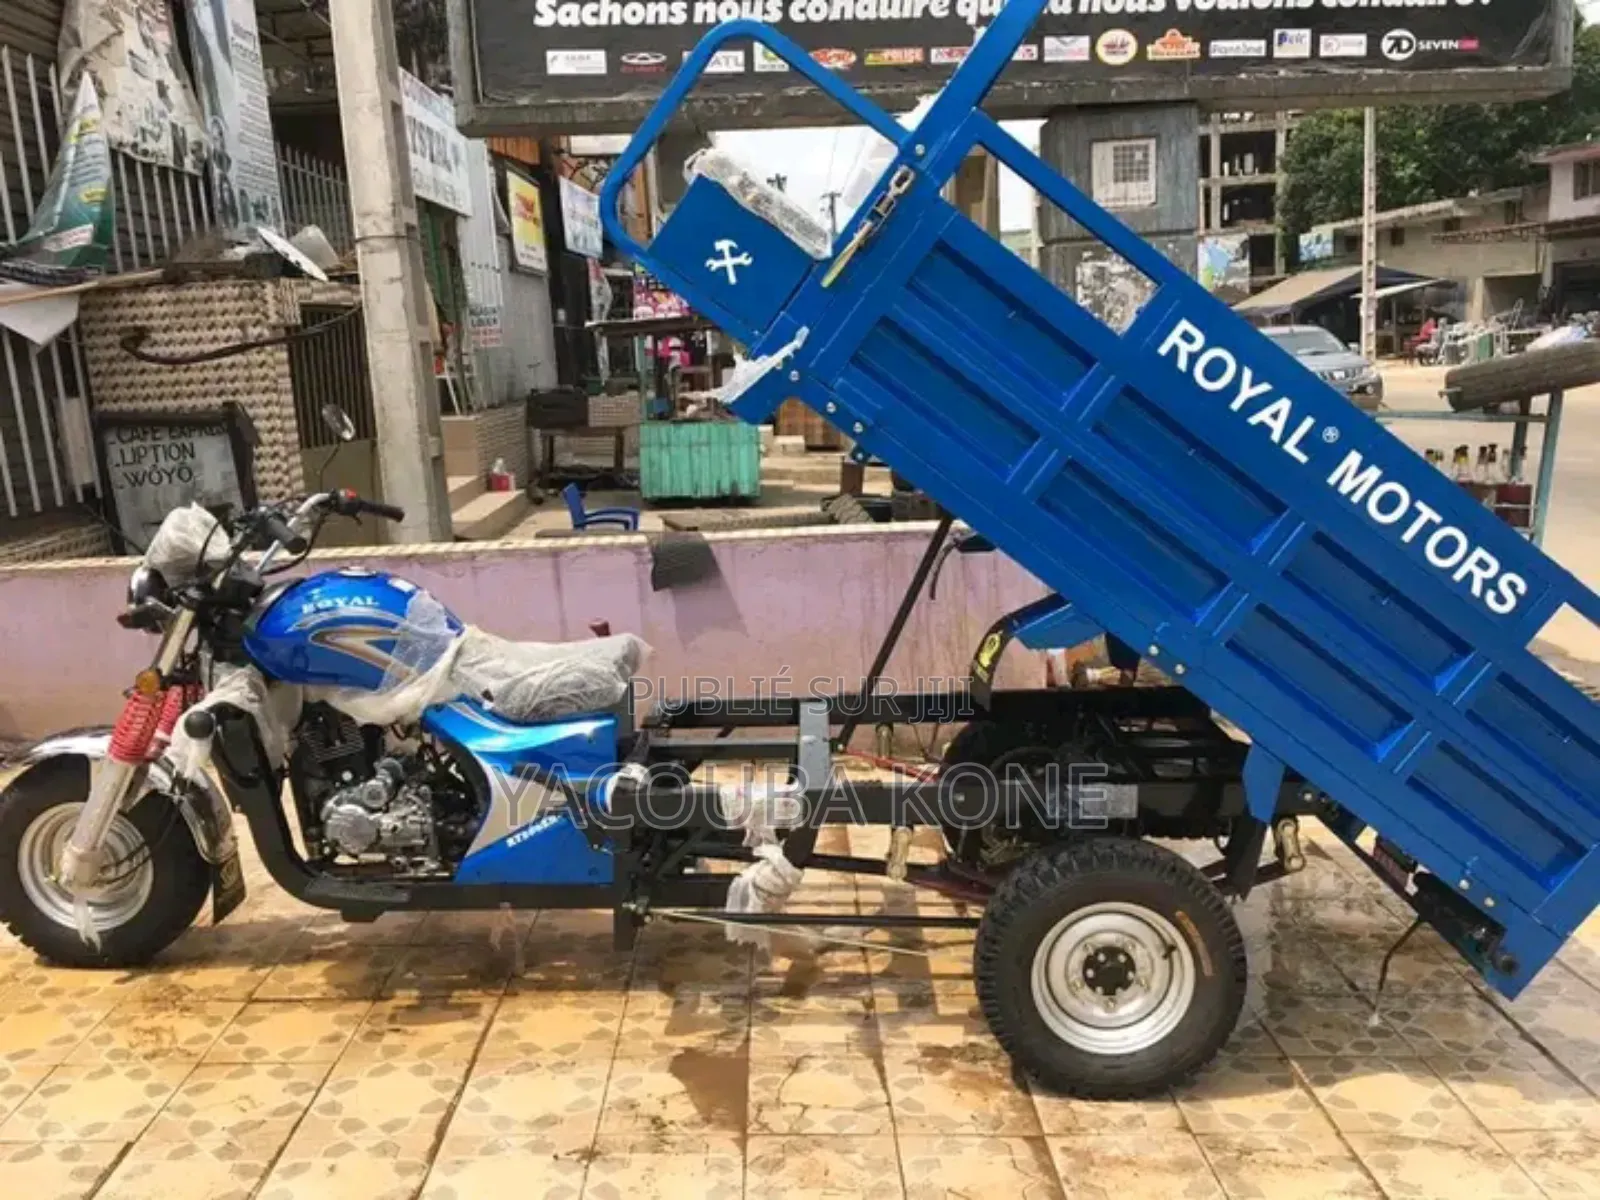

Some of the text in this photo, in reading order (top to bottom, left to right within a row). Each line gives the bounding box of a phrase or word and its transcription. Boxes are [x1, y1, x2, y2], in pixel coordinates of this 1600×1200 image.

[533, 0, 688, 27] Sachons
[693, 0, 783, 24] nous
[789, 0, 949, 22] conduire
[1418, 39, 1459, 50] SEVEN
[1327, 449, 1528, 614] MOTORS
